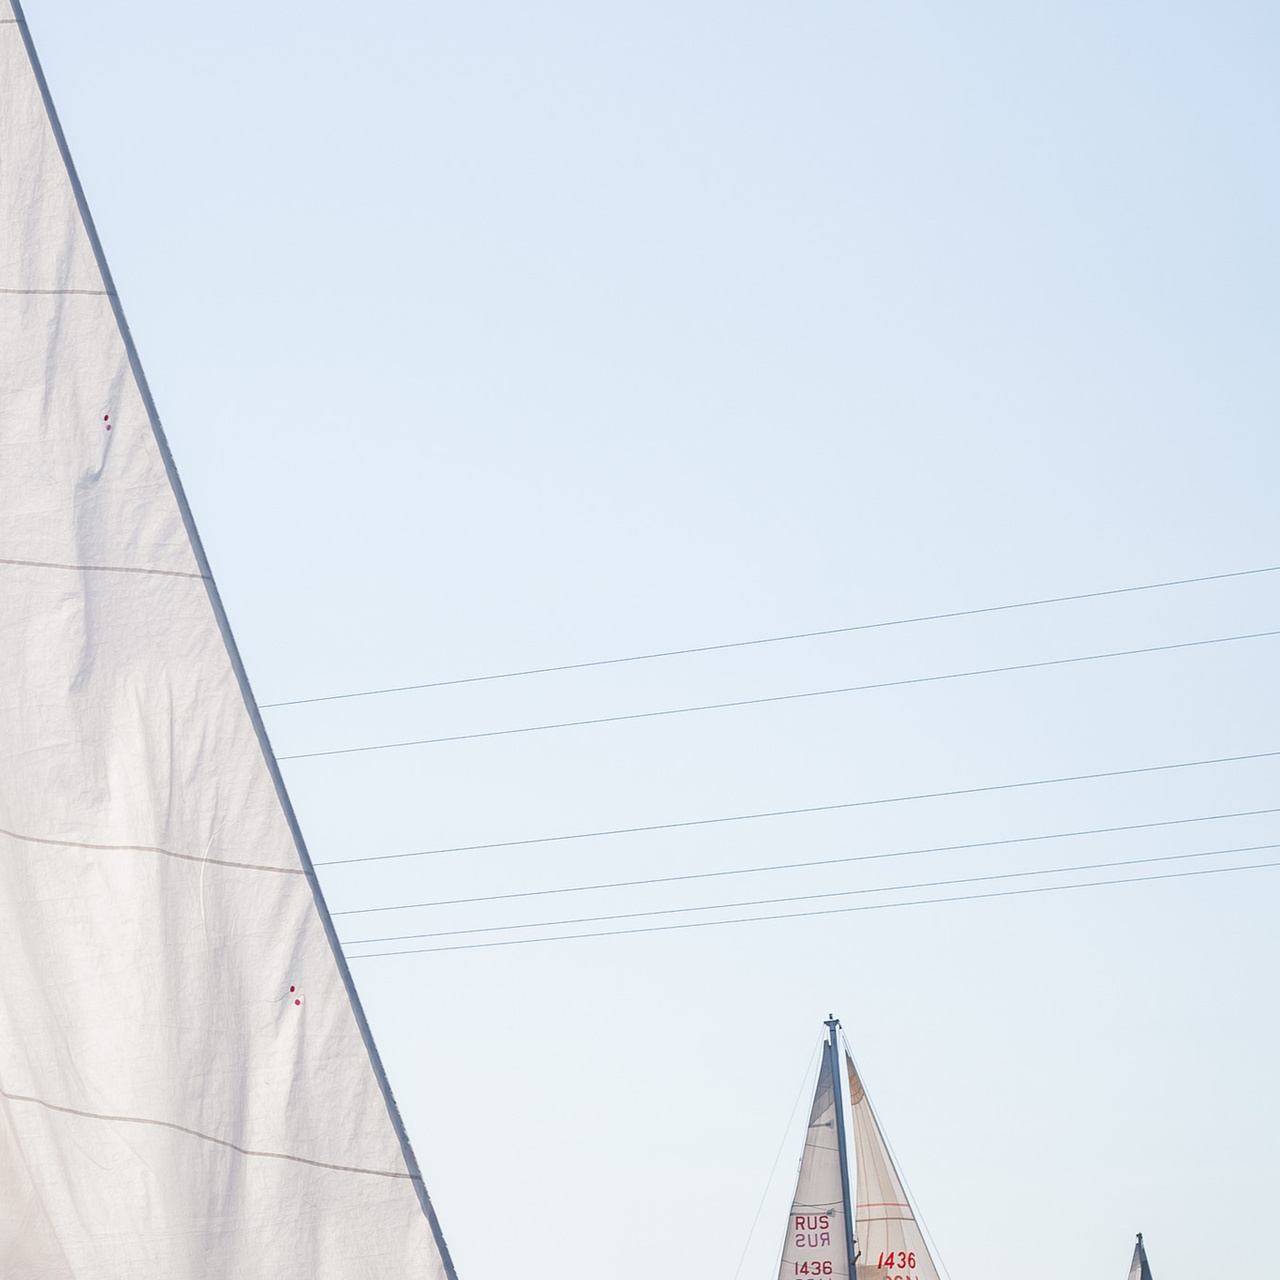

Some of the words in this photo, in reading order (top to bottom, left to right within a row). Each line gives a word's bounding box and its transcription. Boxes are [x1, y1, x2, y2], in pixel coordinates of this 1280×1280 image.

[795, 1215, 830, 1230] RUS
[794, 1260, 833, 1276] 1436
[877, 1251, 916, 1269] 1436
